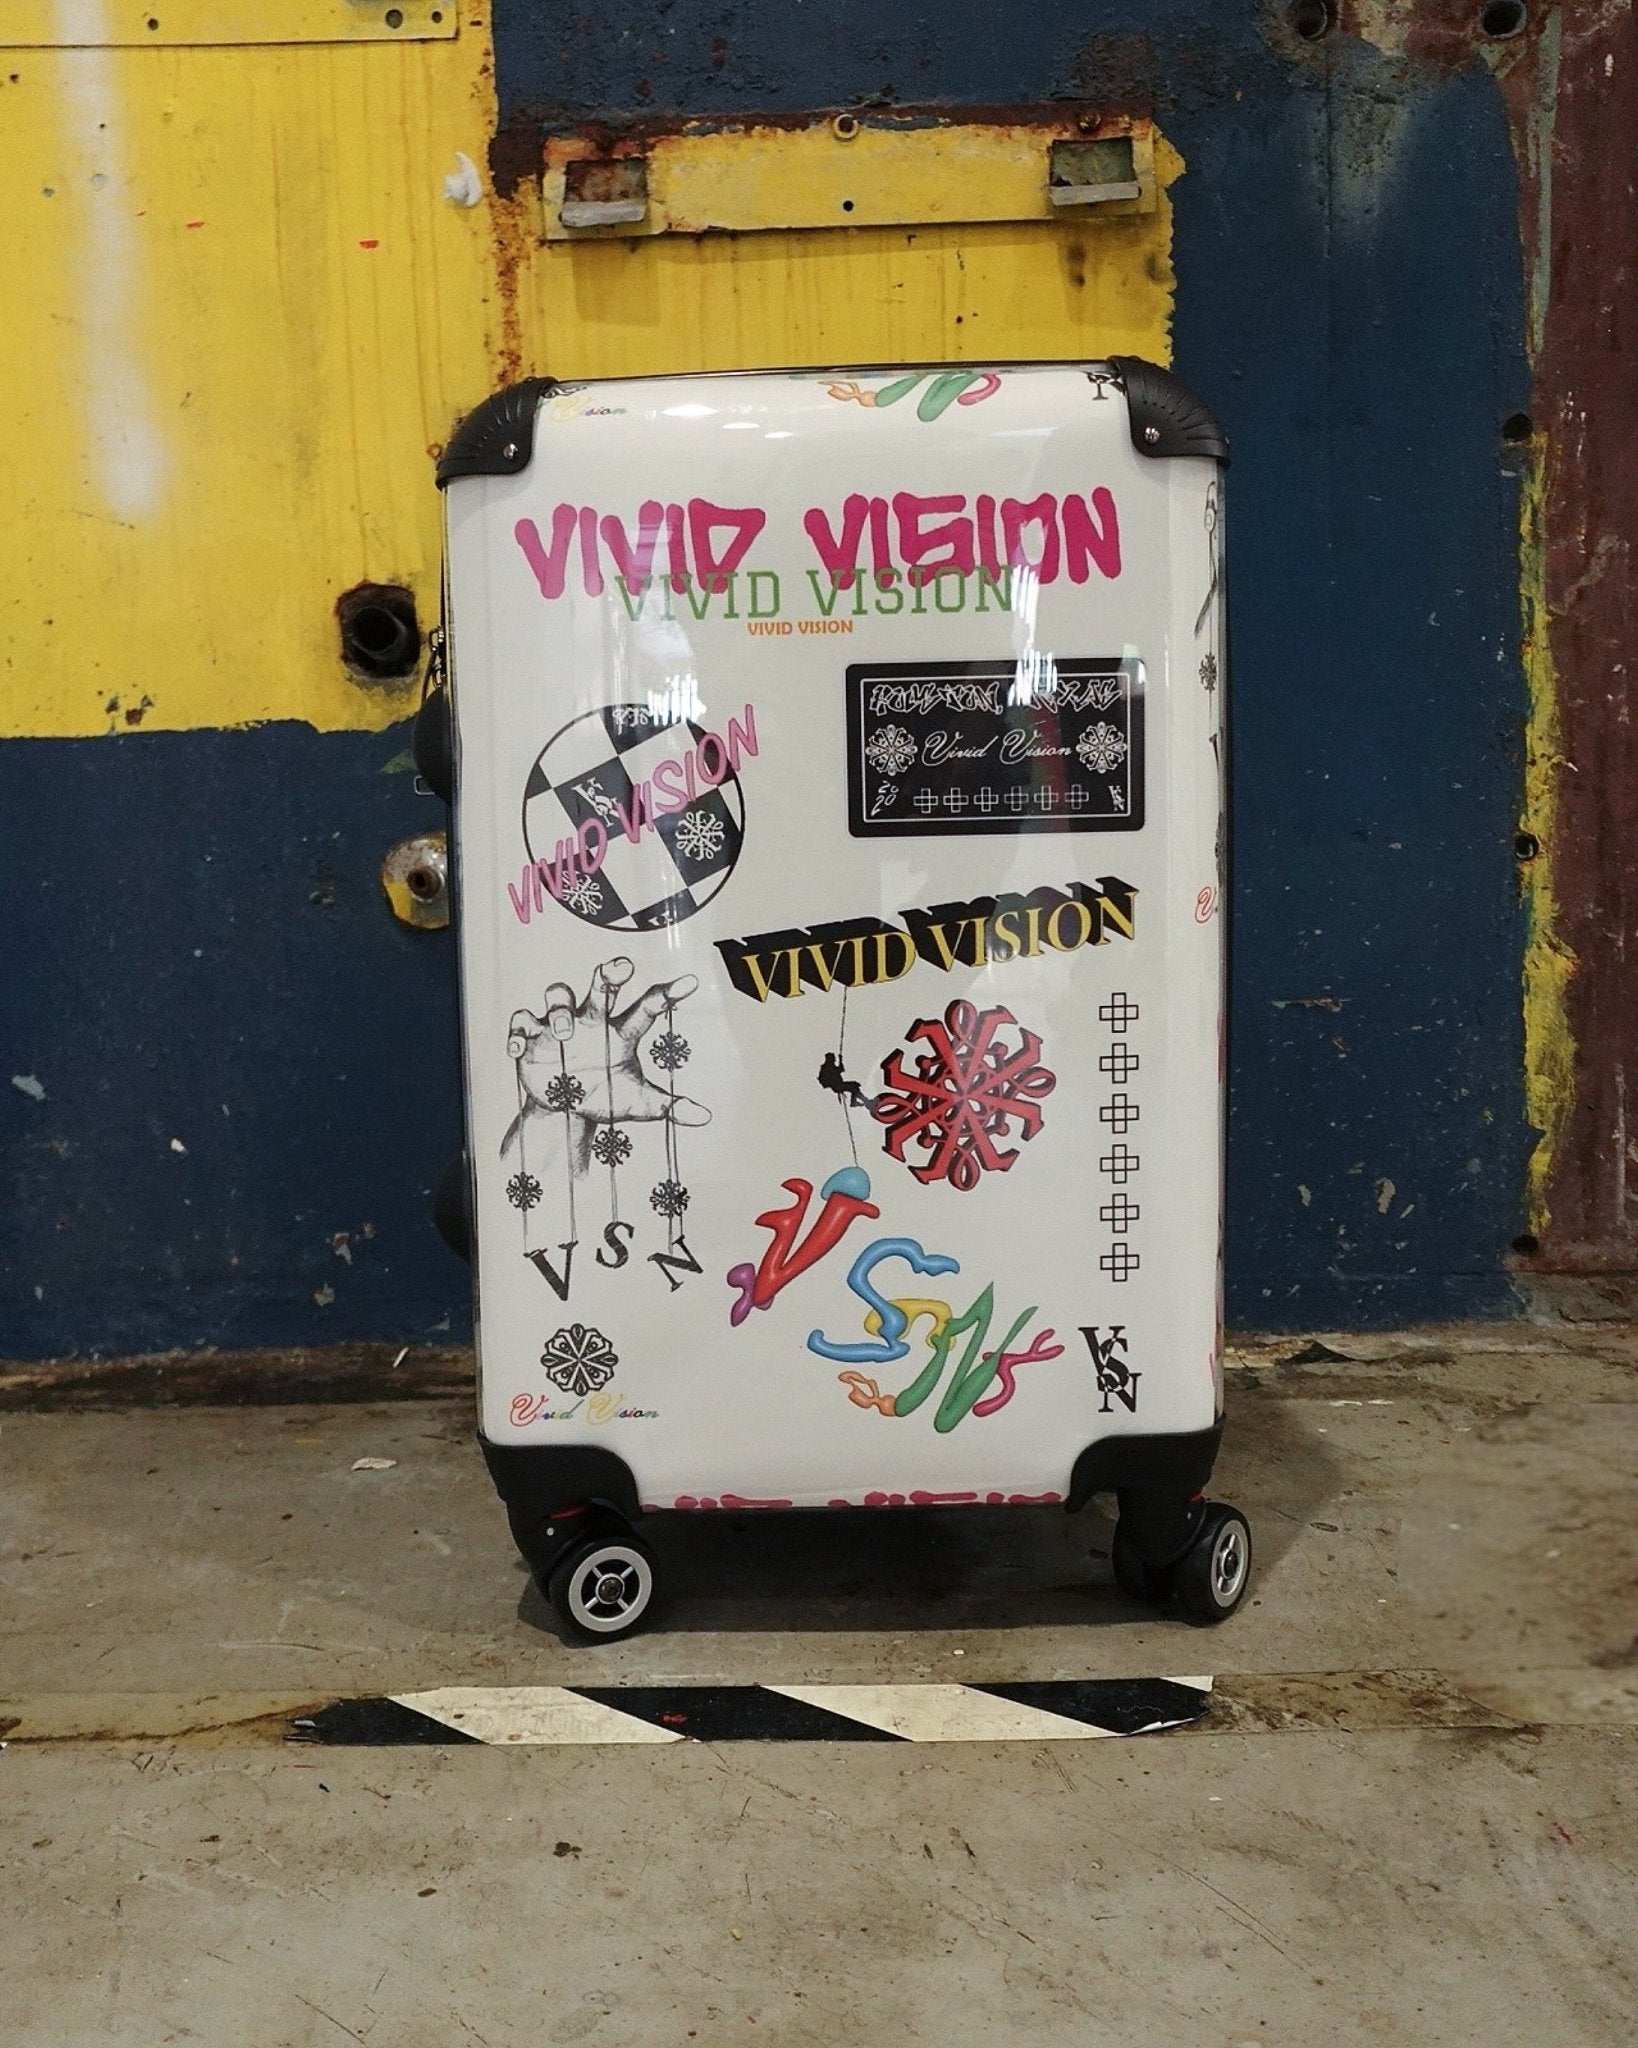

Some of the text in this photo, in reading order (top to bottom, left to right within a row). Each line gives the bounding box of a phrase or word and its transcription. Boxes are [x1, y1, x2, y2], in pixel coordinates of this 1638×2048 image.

[514, 486, 1121, 600] VIVID VISION
[615, 565, 1015, 622] VIVID VISION
[747, 619, 853, 636] VIVID VISION
[922, 728, 1072, 767] Vivid Vision
[507, 703, 759, 924] VIVID VISION
[742, 930, 918, 1003] VIVID
[927, 890, 1139, 973] VISION
